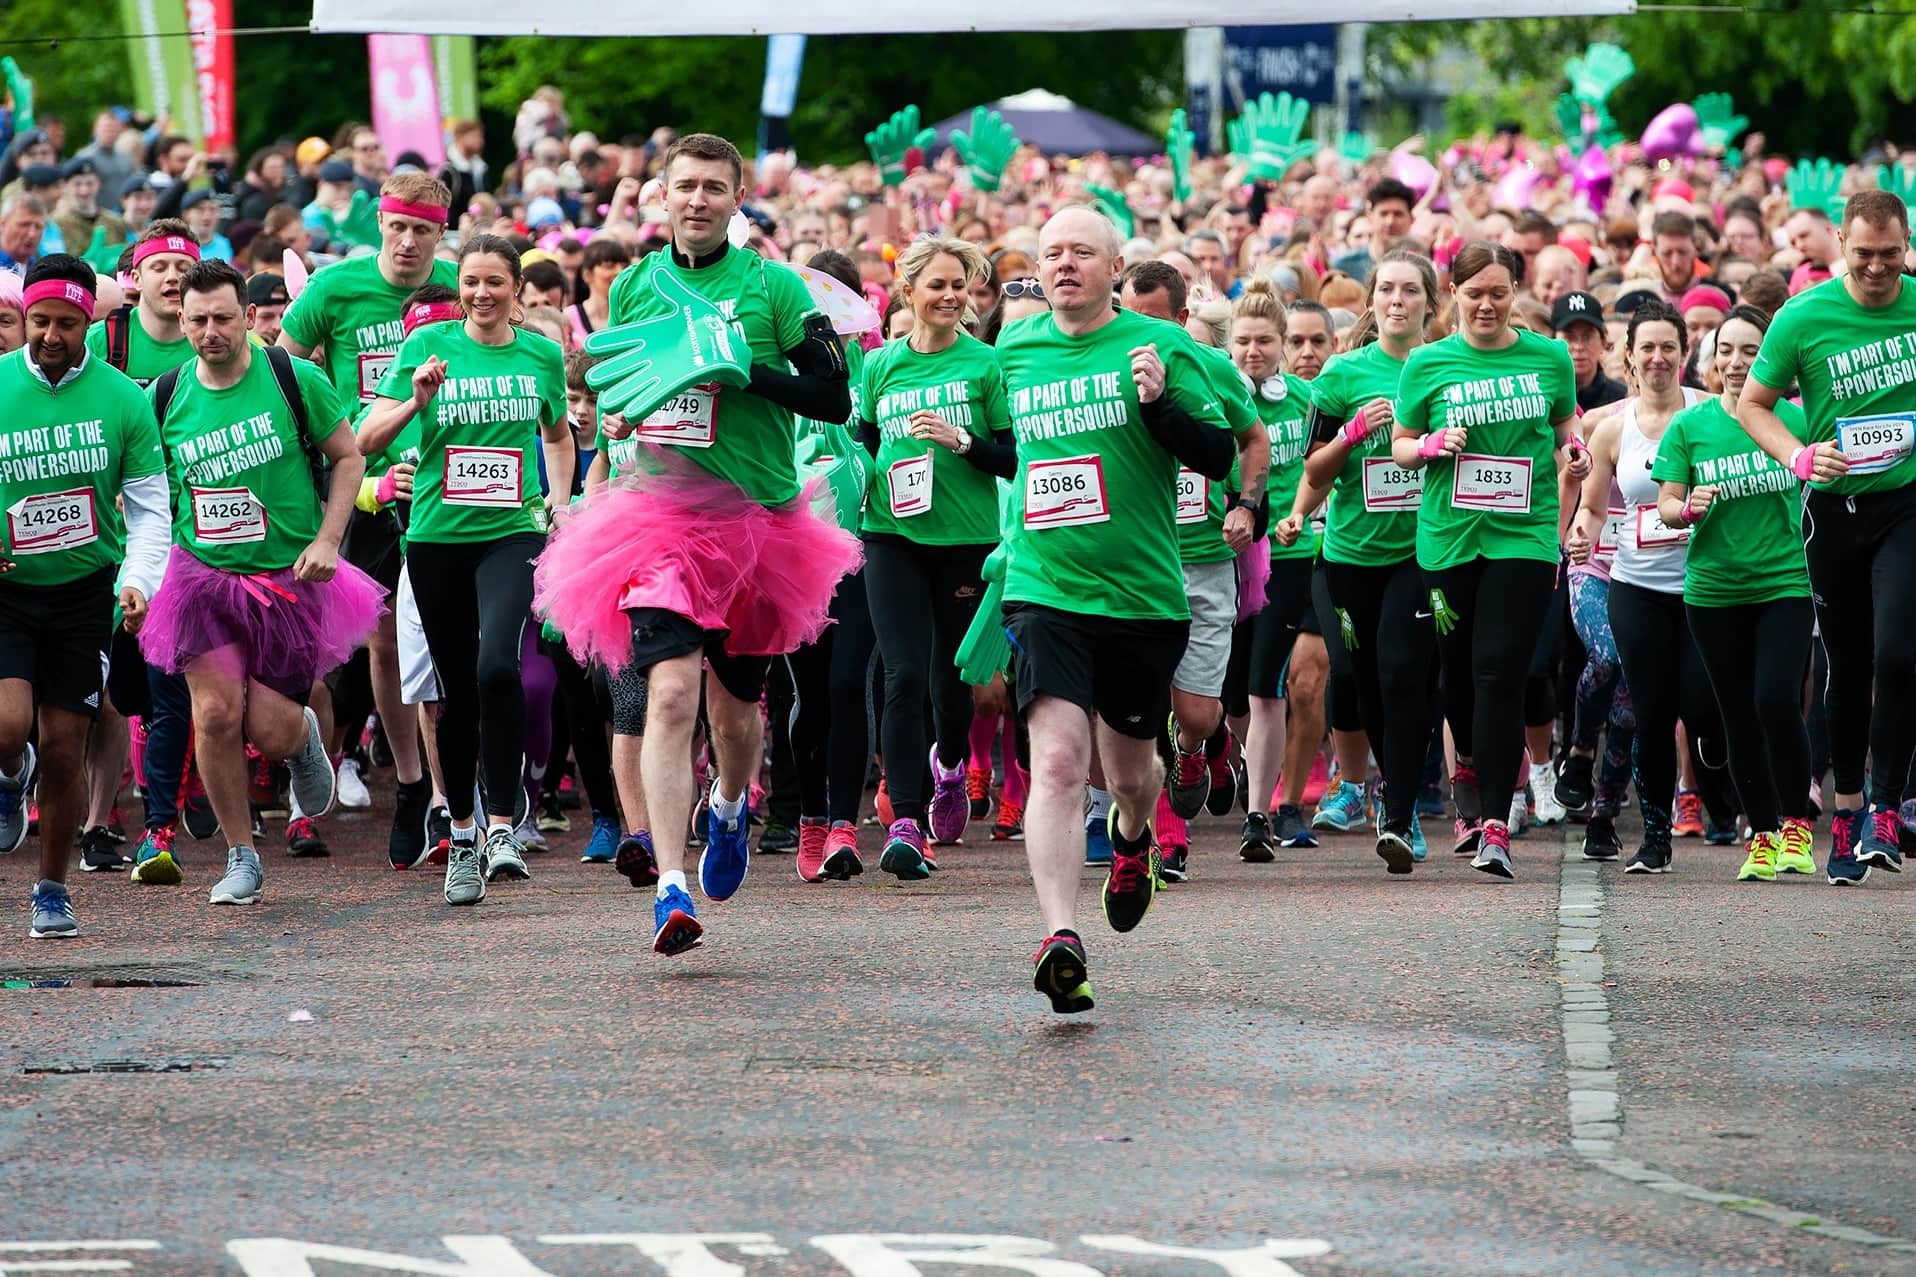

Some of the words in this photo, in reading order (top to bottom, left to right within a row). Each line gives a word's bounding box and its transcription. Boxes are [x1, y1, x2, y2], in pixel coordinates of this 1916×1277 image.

[714, 298, 739, 321] HE
[356, 325, 378, 348] I'M
[1827, 352, 1852, 379] I'M
[1850, 340, 1885, 371] PART
[1885, 336, 1904, 360] OF
[460, 376, 493, 400] PART
[496, 375, 514, 398] OF
[515, 374, 538, 397] THE
[892, 388, 923, 415] PART
[925, 385, 943, 407] OF
[944, 381, 969, 404] THE
[1032, 379, 1068, 411] PART
[1070, 376, 1090, 404] OF
[1091, 371, 1122, 400] THE
[1463, 378, 1497, 403] PART
[1498, 376, 1516, 397] OF
[1515, 373, 1543, 394] THE
[437, 398, 540, 427] #POWERSQUAD
[1015, 400, 1128, 446] #POWERSQUAD
[1446, 395, 1546, 429] #POWERSQUAD
[13, 427, 50, 456] PART
[53, 423, 73, 449] OF
[75, 419, 106, 447] THE
[177, 438, 198, 466] I'M
[196, 427, 231, 457] PART
[230, 421, 247, 447] OF
[247, 411, 276, 440] THE
[1267, 422, 1283, 444] OF
[1284, 418, 1303, 441] THE
[1852, 428, 1904, 446] 10993
[185, 435, 284, 486] #POWERSQUAD
[456, 462, 509, 479] 14263
[1695, 459, 1718, 484] I'M
[1717, 452, 1751, 479] PART
[1751, 449, 1769, 472] OF
[1032, 474, 1086, 495] 13086
[1383, 469, 1420, 484] 1834
[1474, 468, 1512, 485] 1833
[22, 504, 81, 528] 14268
[201, 501, 252, 519] 14262
